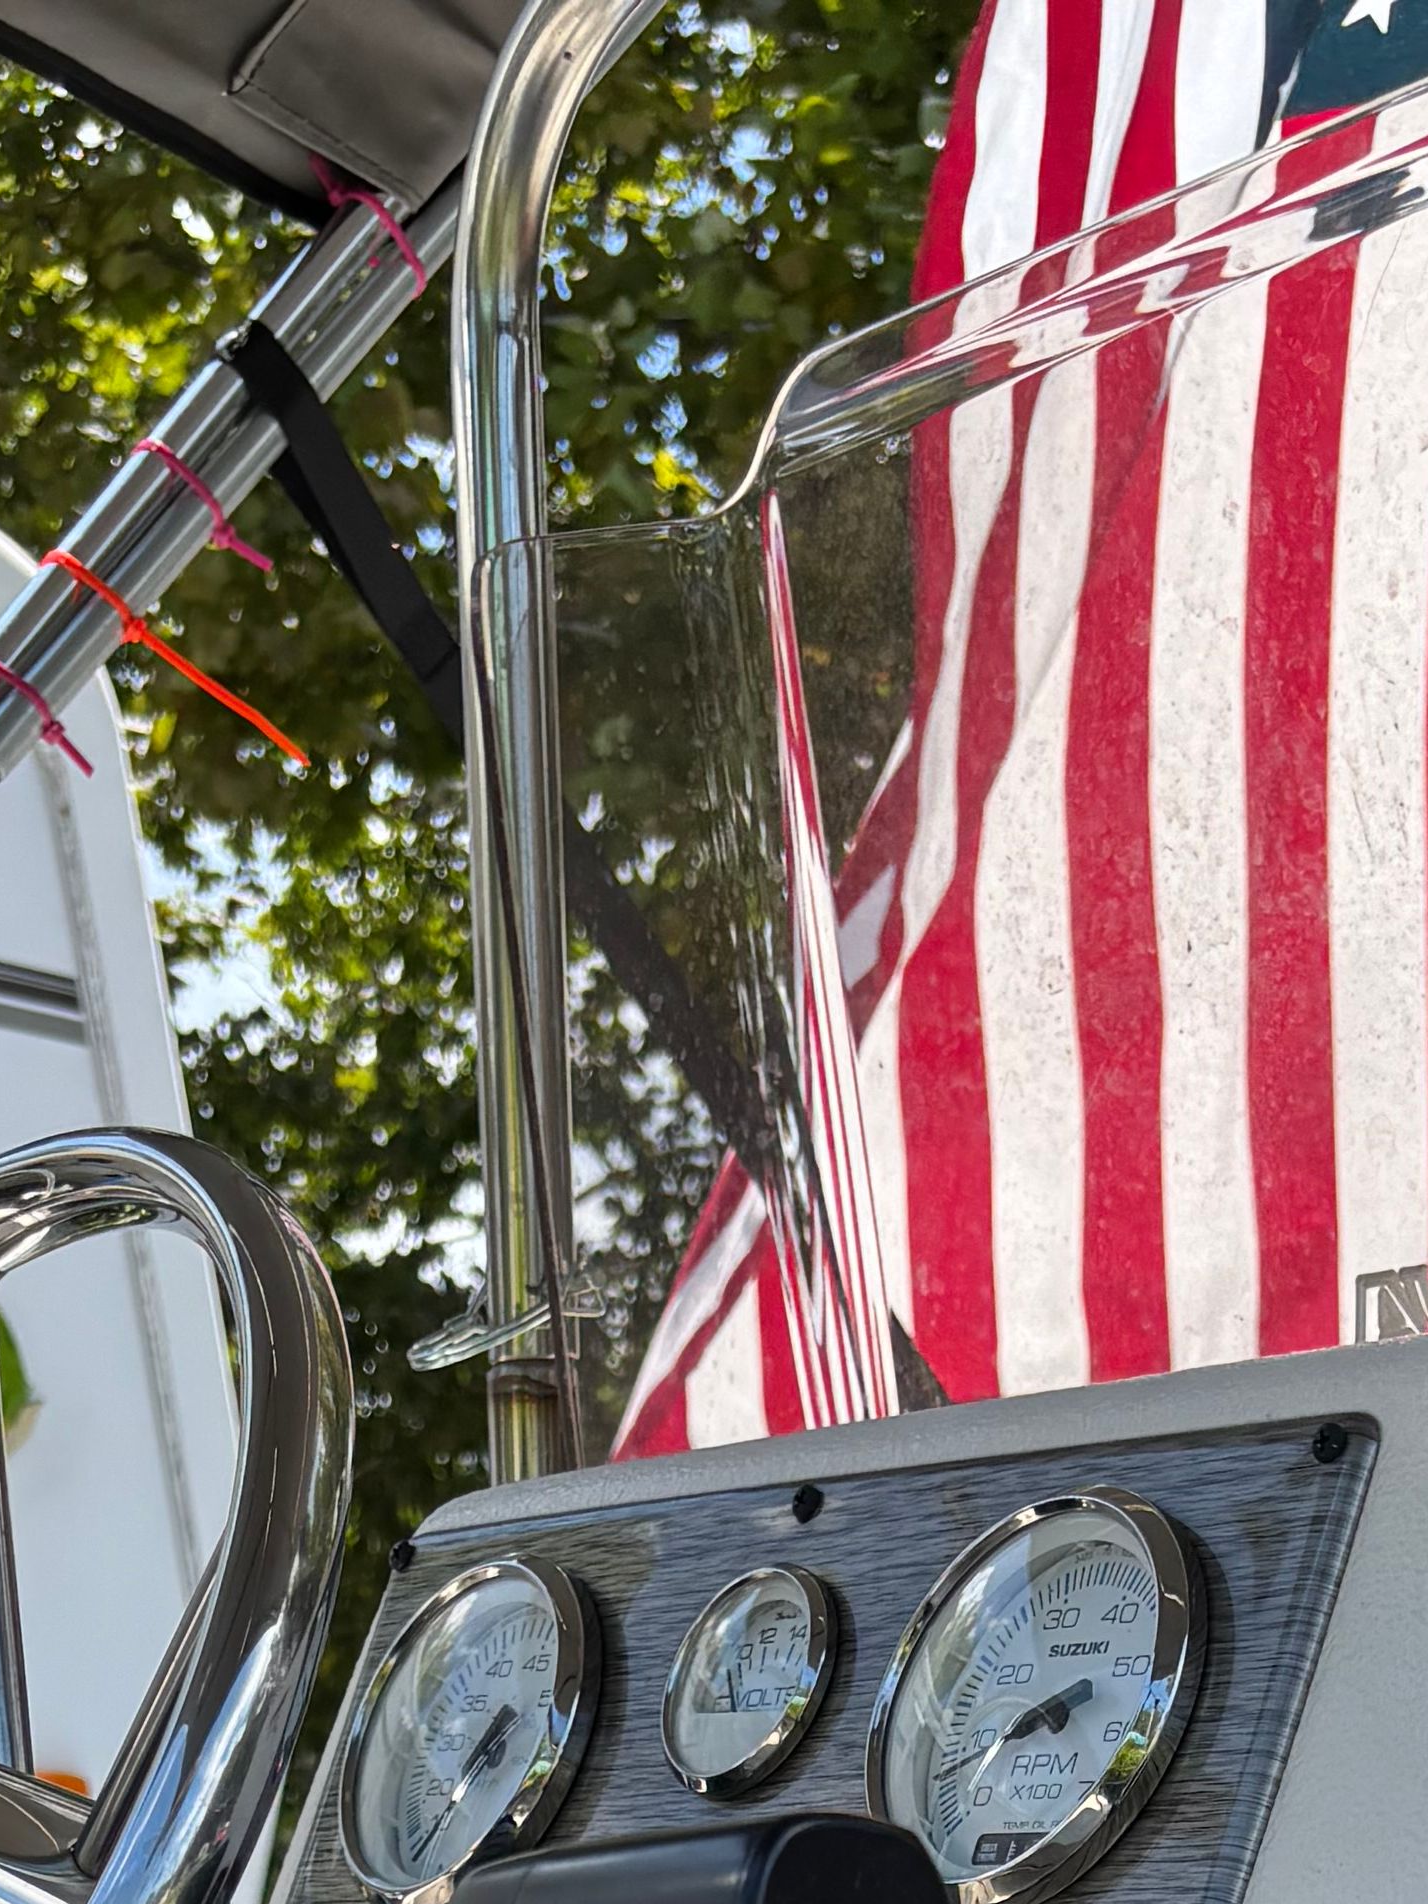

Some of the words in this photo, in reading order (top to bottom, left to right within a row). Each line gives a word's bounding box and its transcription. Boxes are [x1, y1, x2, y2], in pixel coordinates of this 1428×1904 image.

[1043, 1608, 1081, 1630] 30
[1100, 1603, 1139, 1624] 40
[758, 1627, 778, 1645] 12
[789, 1624, 808, 1641] 14
[1048, 1640, 1110, 1658] SUZUKI
[485, 1660, 513, 1678] 40
[522, 1654, 552, 1672] 45
[996, 1663, 1034, 1685] 20
[1112, 1655, 1151, 1677] 50
[460, 1694, 489, 1713] 35
[971, 1728, 997, 1750] 10
[1103, 1721, 1129, 1742] 6
[437, 1733, 466, 1752] 30
[1010, 1752, 1079, 1776] RPM
[425, 1778, 455, 1796] 20
[973, 1786, 993, 1806] 0
[1009, 1784, 1062, 1800] X100
